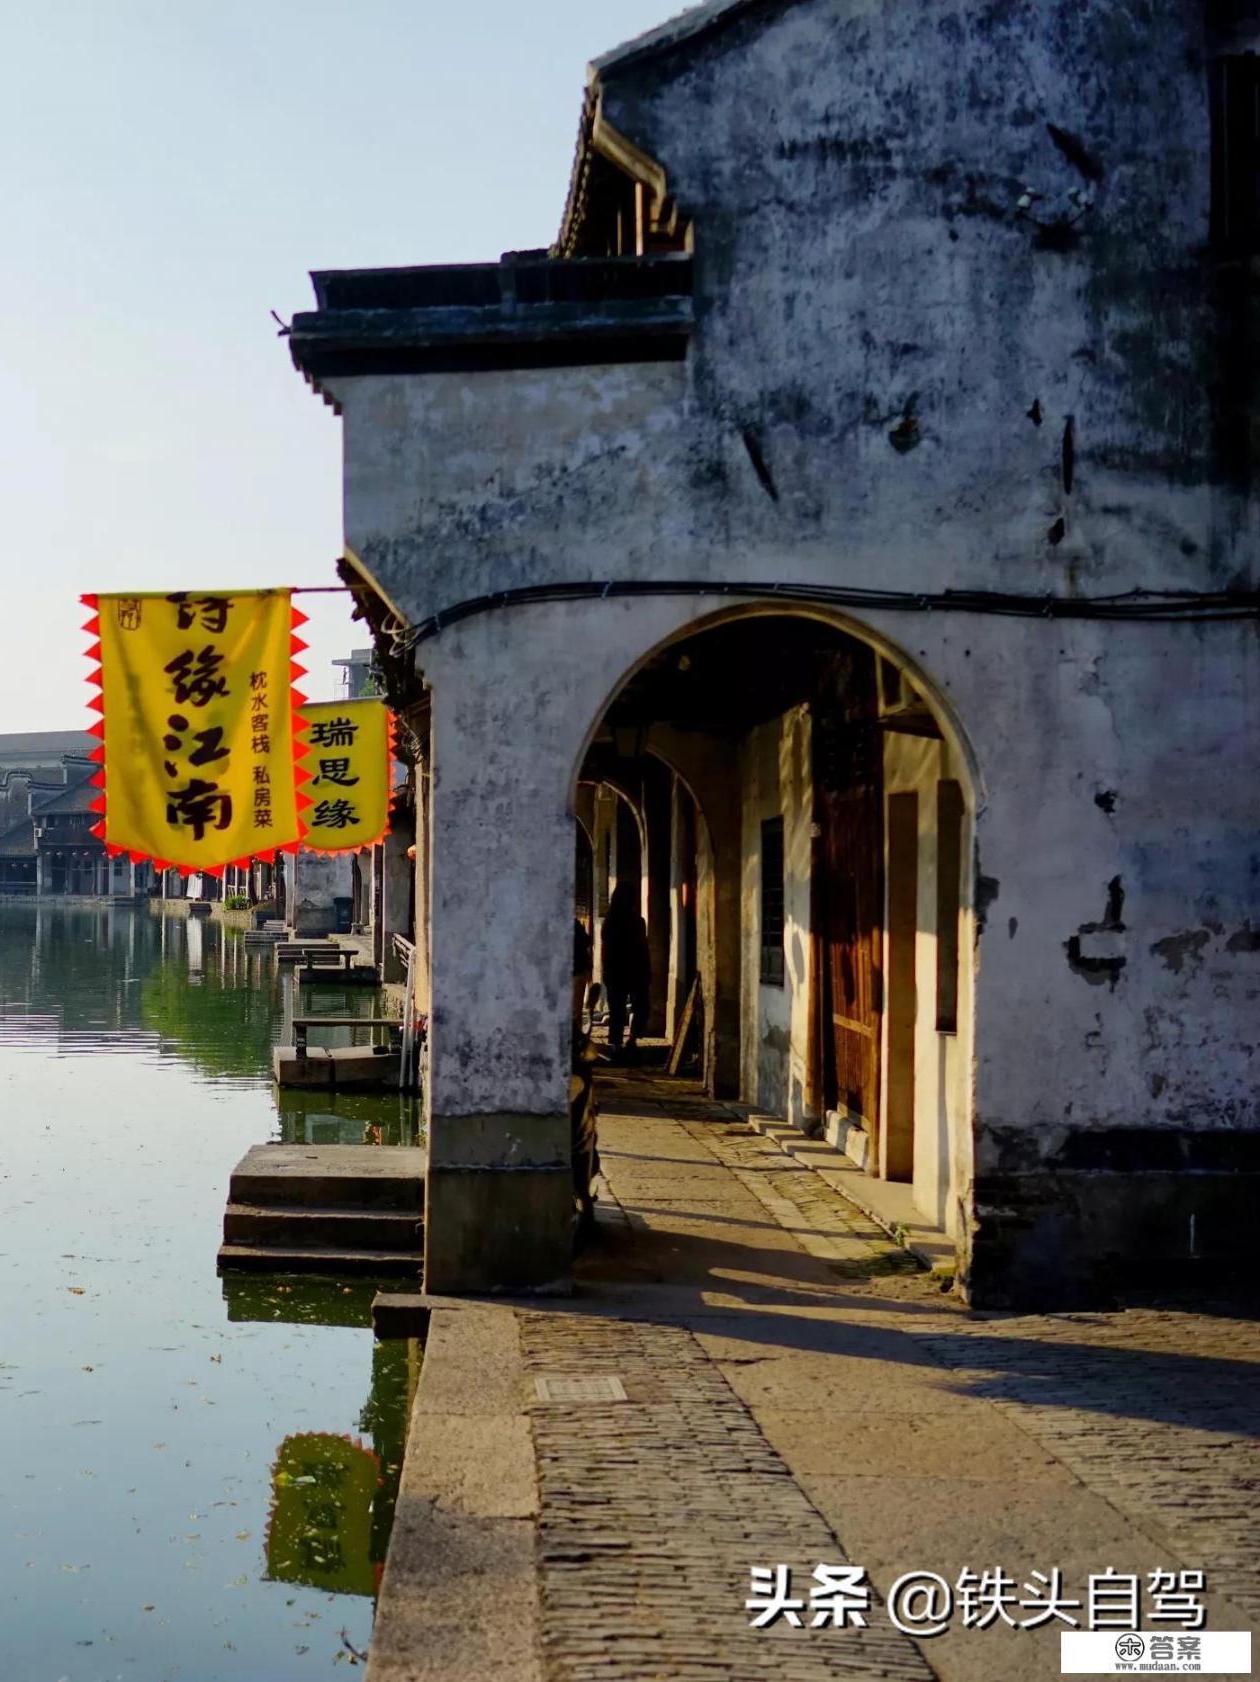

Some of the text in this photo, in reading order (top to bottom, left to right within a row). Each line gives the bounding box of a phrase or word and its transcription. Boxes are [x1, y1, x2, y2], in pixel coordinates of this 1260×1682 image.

[249, 670, 273, 829] 枕水客栈 私房菜
[309, 716, 360, 829] 瑞思缘
